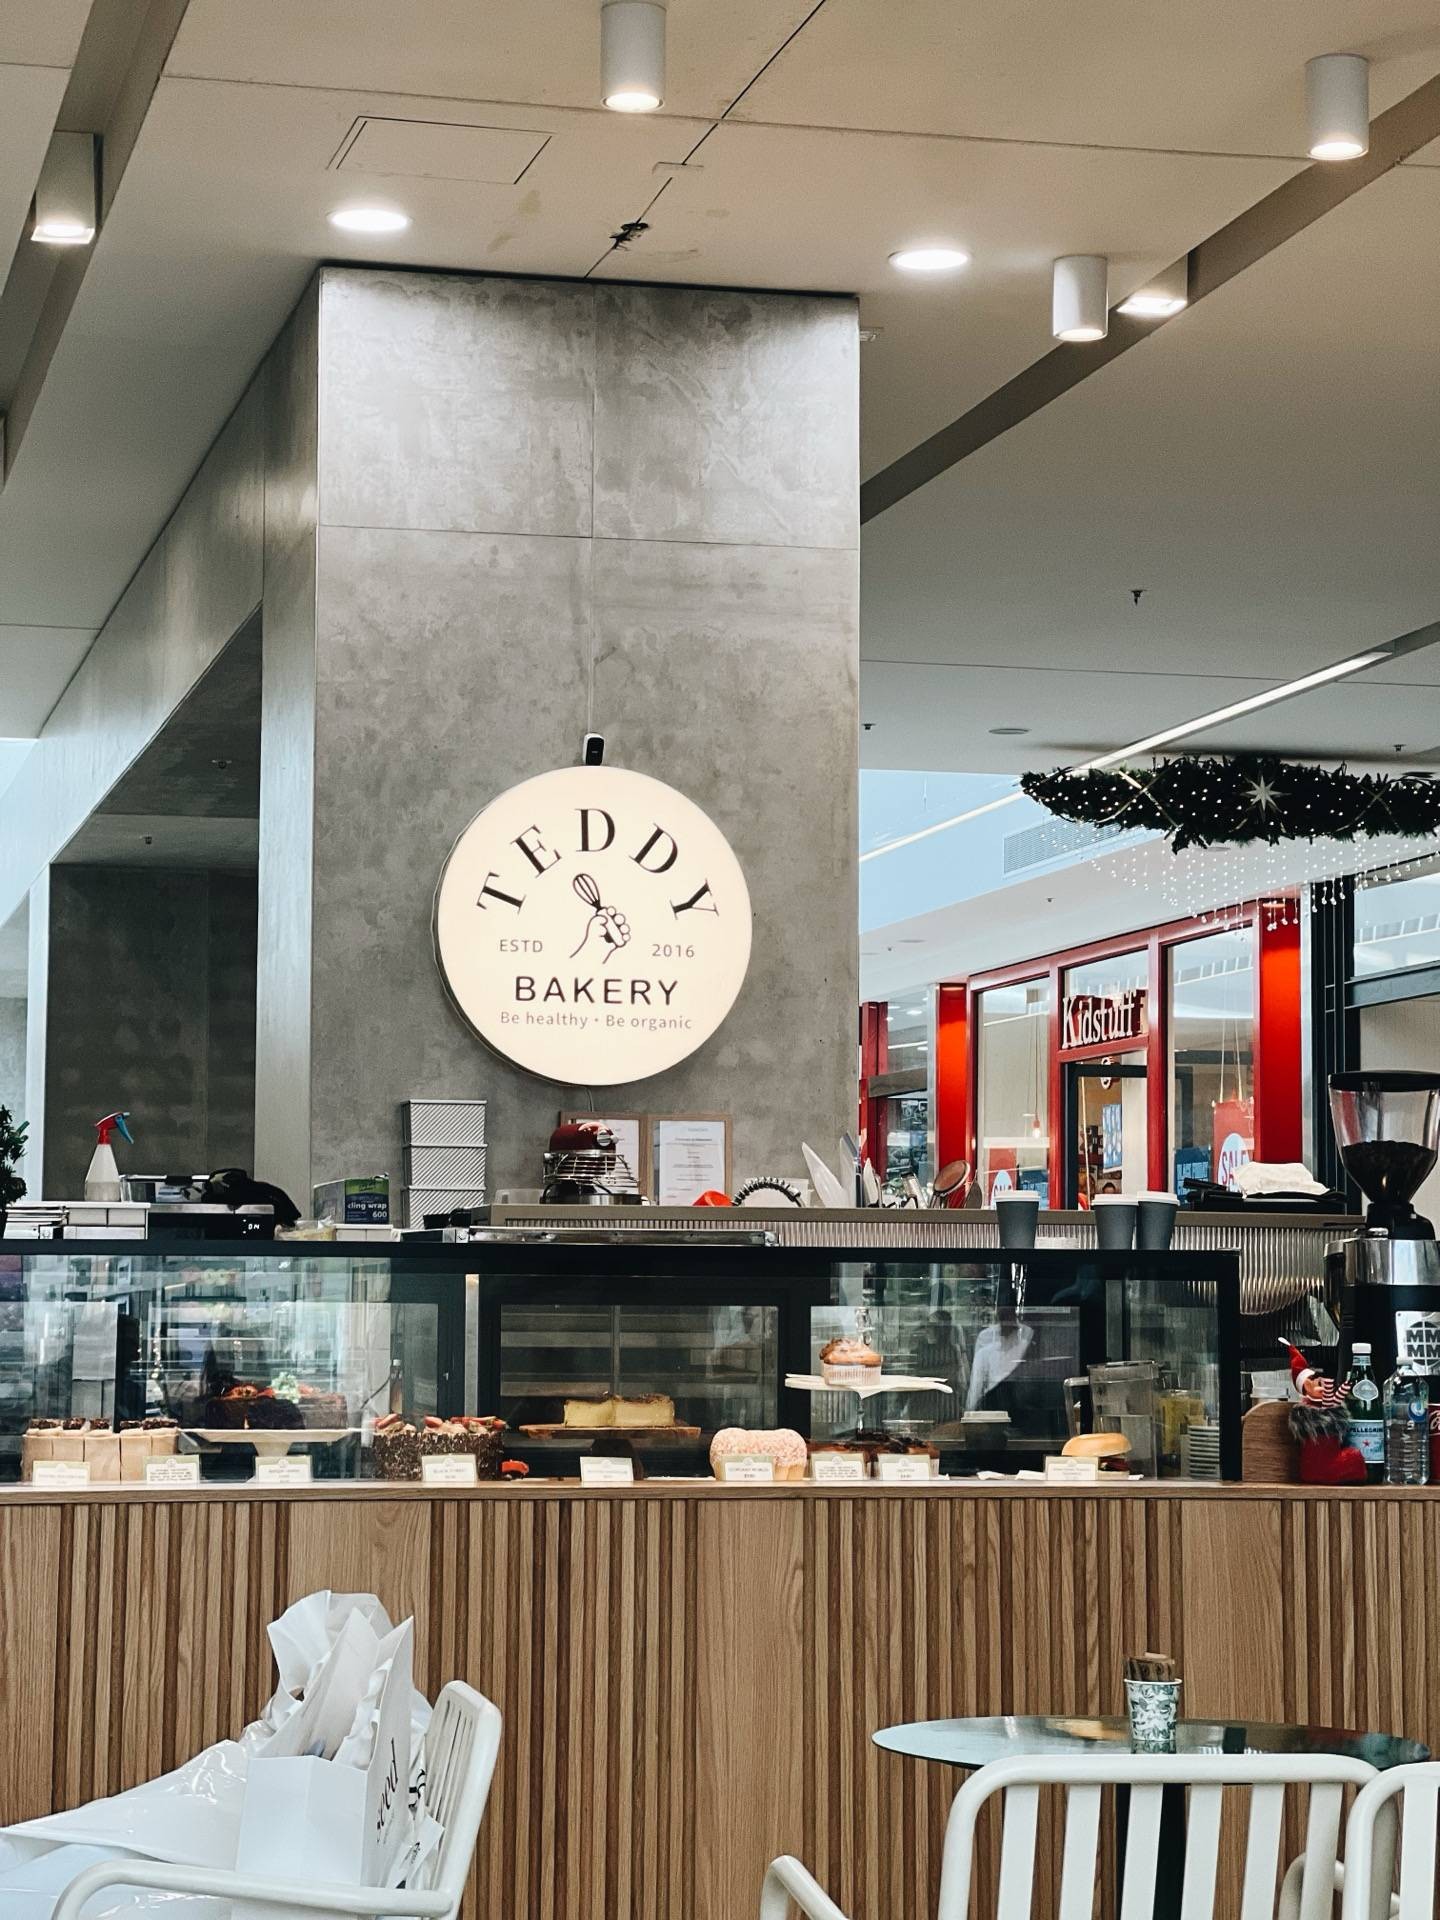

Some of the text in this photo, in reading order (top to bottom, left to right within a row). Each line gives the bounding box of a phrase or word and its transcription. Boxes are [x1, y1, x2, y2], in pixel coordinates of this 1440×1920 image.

[475, 807, 719, 920] TEDDY
[499, 938, 696, 958] ESTD 2016
[514, 975, 679, 1006] BAKERY
[500, 1011, 692, 1031] Be healthy Be organic
[1061, 990, 1136, 1050] Kidstuff
[347, 1201, 387, 1211] cling wrap
[372, 1210, 388, 1218] 600
